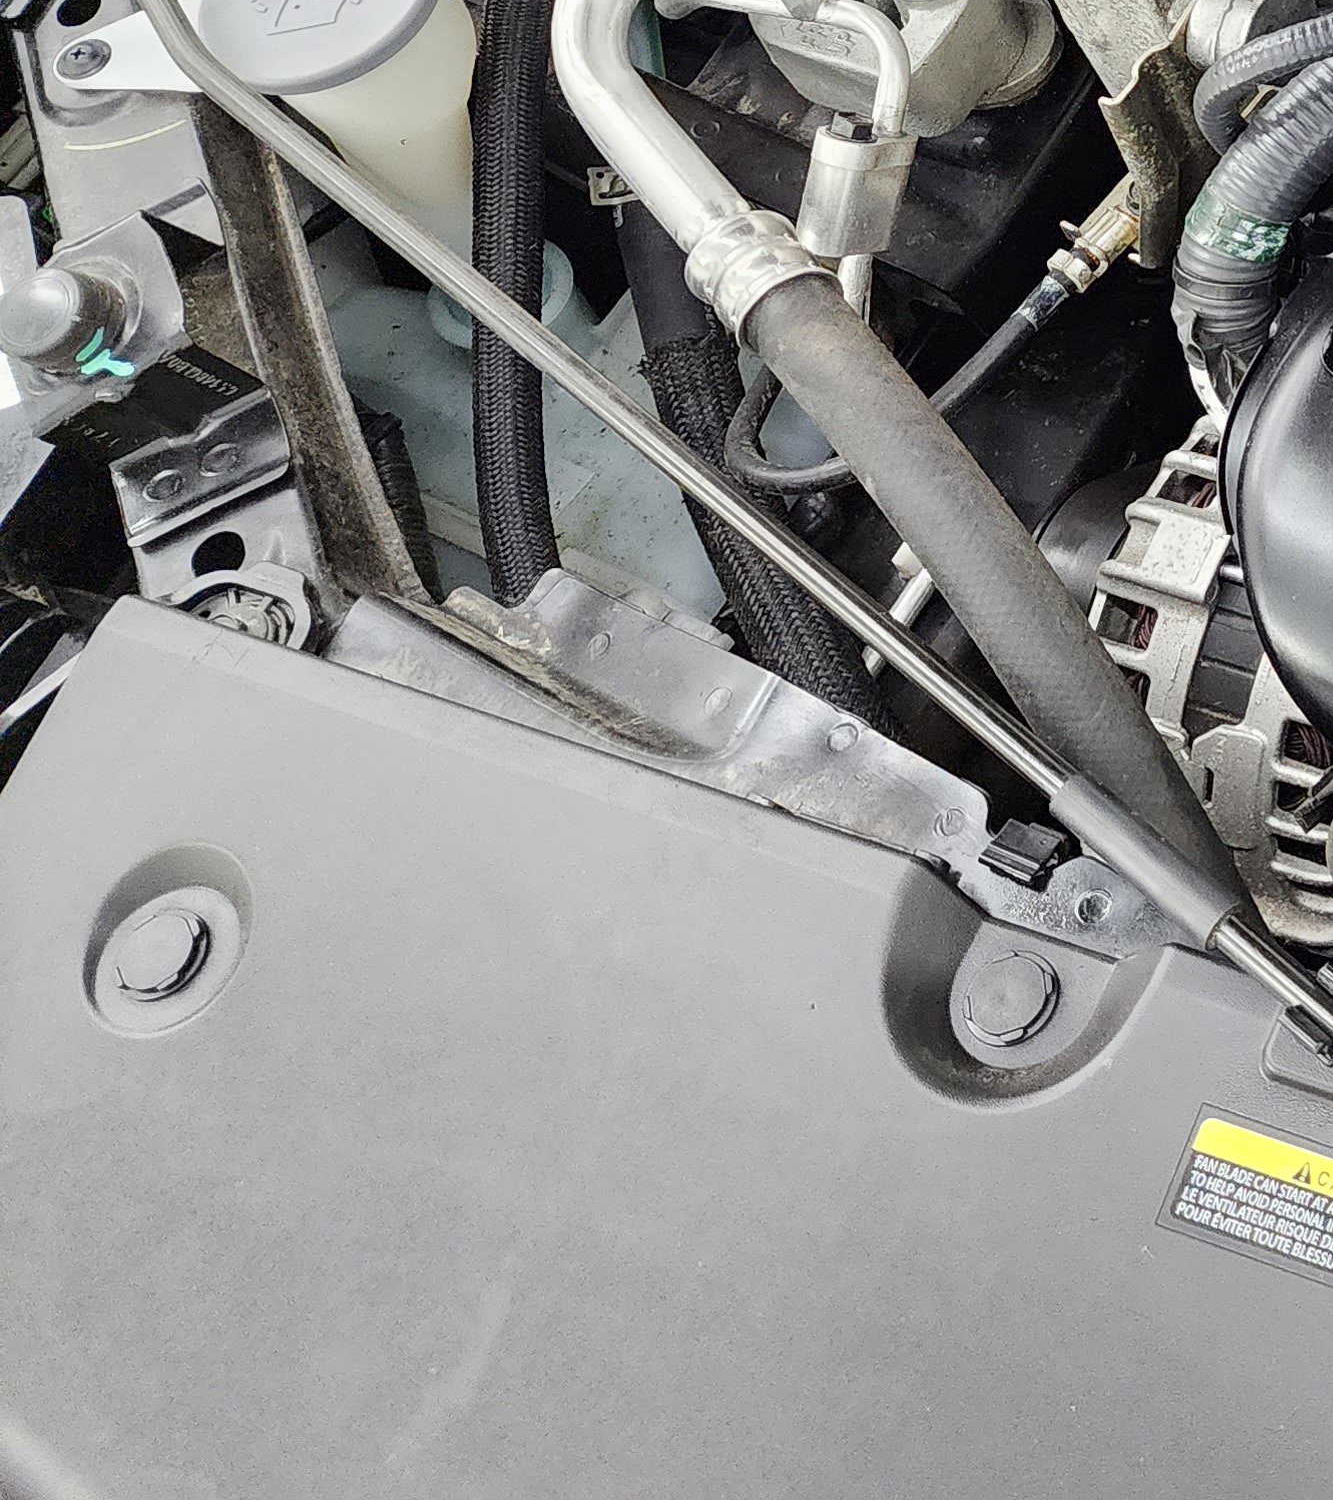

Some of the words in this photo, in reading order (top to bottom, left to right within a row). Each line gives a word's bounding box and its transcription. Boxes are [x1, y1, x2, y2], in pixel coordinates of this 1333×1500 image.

[1189, 1170, 1208, 1187] TO
[1205, 1175, 1236, 1198] HELP
[1232, 1185, 1271, 1210] AVOID
[1268, 1198, 1327, 1229] PERSONAL
[1192, 1153, 1218, 1174] FAN
[1216, 1161, 1255, 1186] BLADE
[1251, 1174, 1280, 1195] CAN
[1277, 1183, 1313, 1206] START
[1310, 1195, 1328, 1211] AT
[1174, 1200, 1212, 1225] POUR
[1209, 1211, 1254, 1239] ÉVITER
[1251, 1228, 1292, 1254] TOUTE
[1181, 1186, 1199, 1203] LE
[1195, 1191, 1276, 1229] VENTILATEUR
[1273, 1218, 1321, 1247] RISQUE
